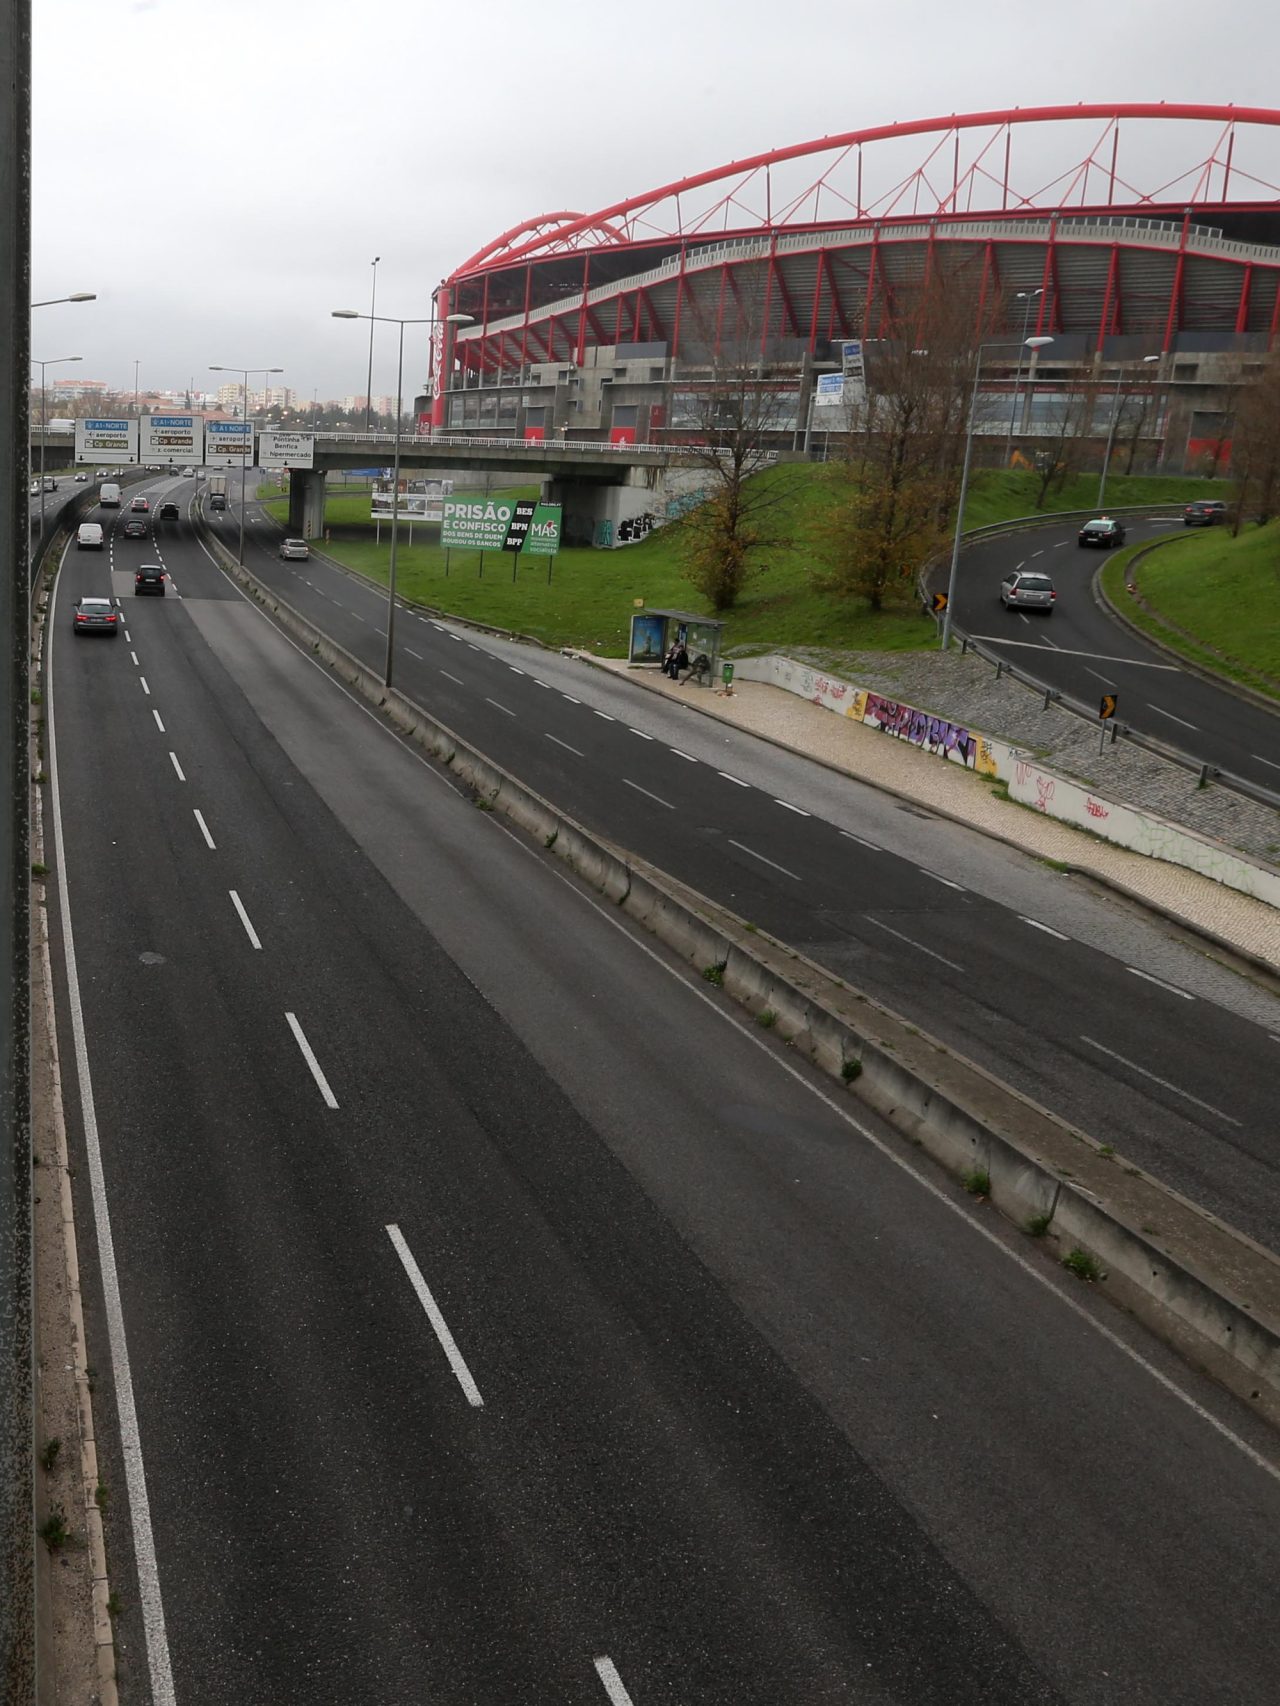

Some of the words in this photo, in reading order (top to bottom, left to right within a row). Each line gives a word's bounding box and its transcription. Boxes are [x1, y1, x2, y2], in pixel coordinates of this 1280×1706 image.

[170, 437, 192, 445] Grande
[444, 501, 511, 521] PRISÃO
[516, 507, 533, 516] BES
[443, 520, 450, 529] E
[452, 521, 506, 532] CONFISCO
[511, 522, 528, 531] BPN
[506, 537, 522, 546] BPP
